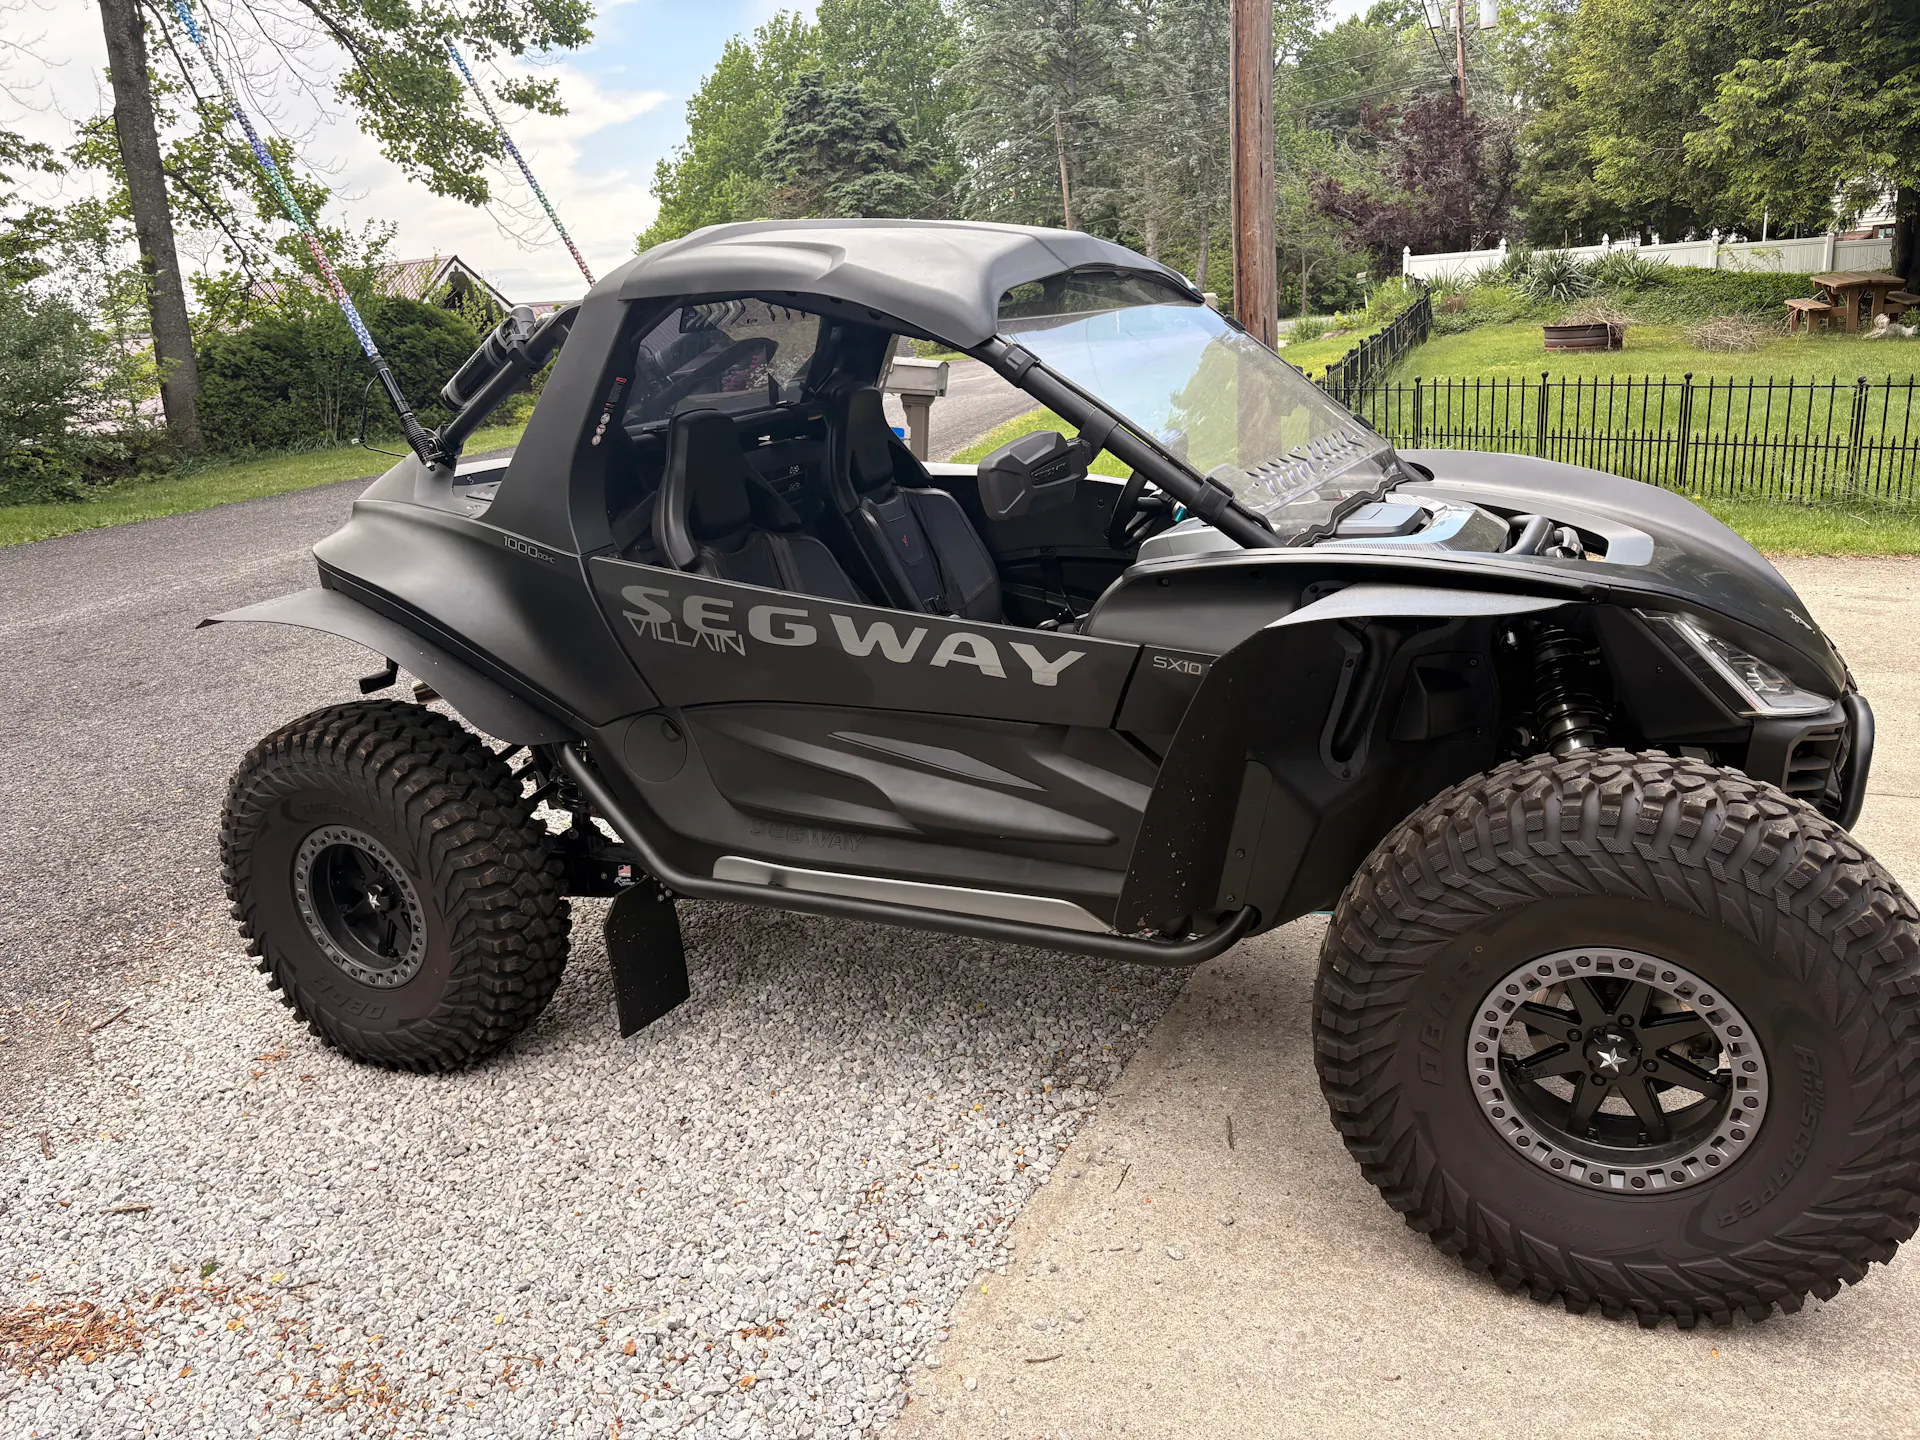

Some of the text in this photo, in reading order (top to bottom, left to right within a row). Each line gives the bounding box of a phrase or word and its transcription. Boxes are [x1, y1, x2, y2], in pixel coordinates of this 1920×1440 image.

[621, 584, 1087, 687] SEGWAY
[624, 613, 746, 657] VILLAIN
[1152, 655, 1202, 675] SX10
[749, 818, 866, 852] SEGWAY
